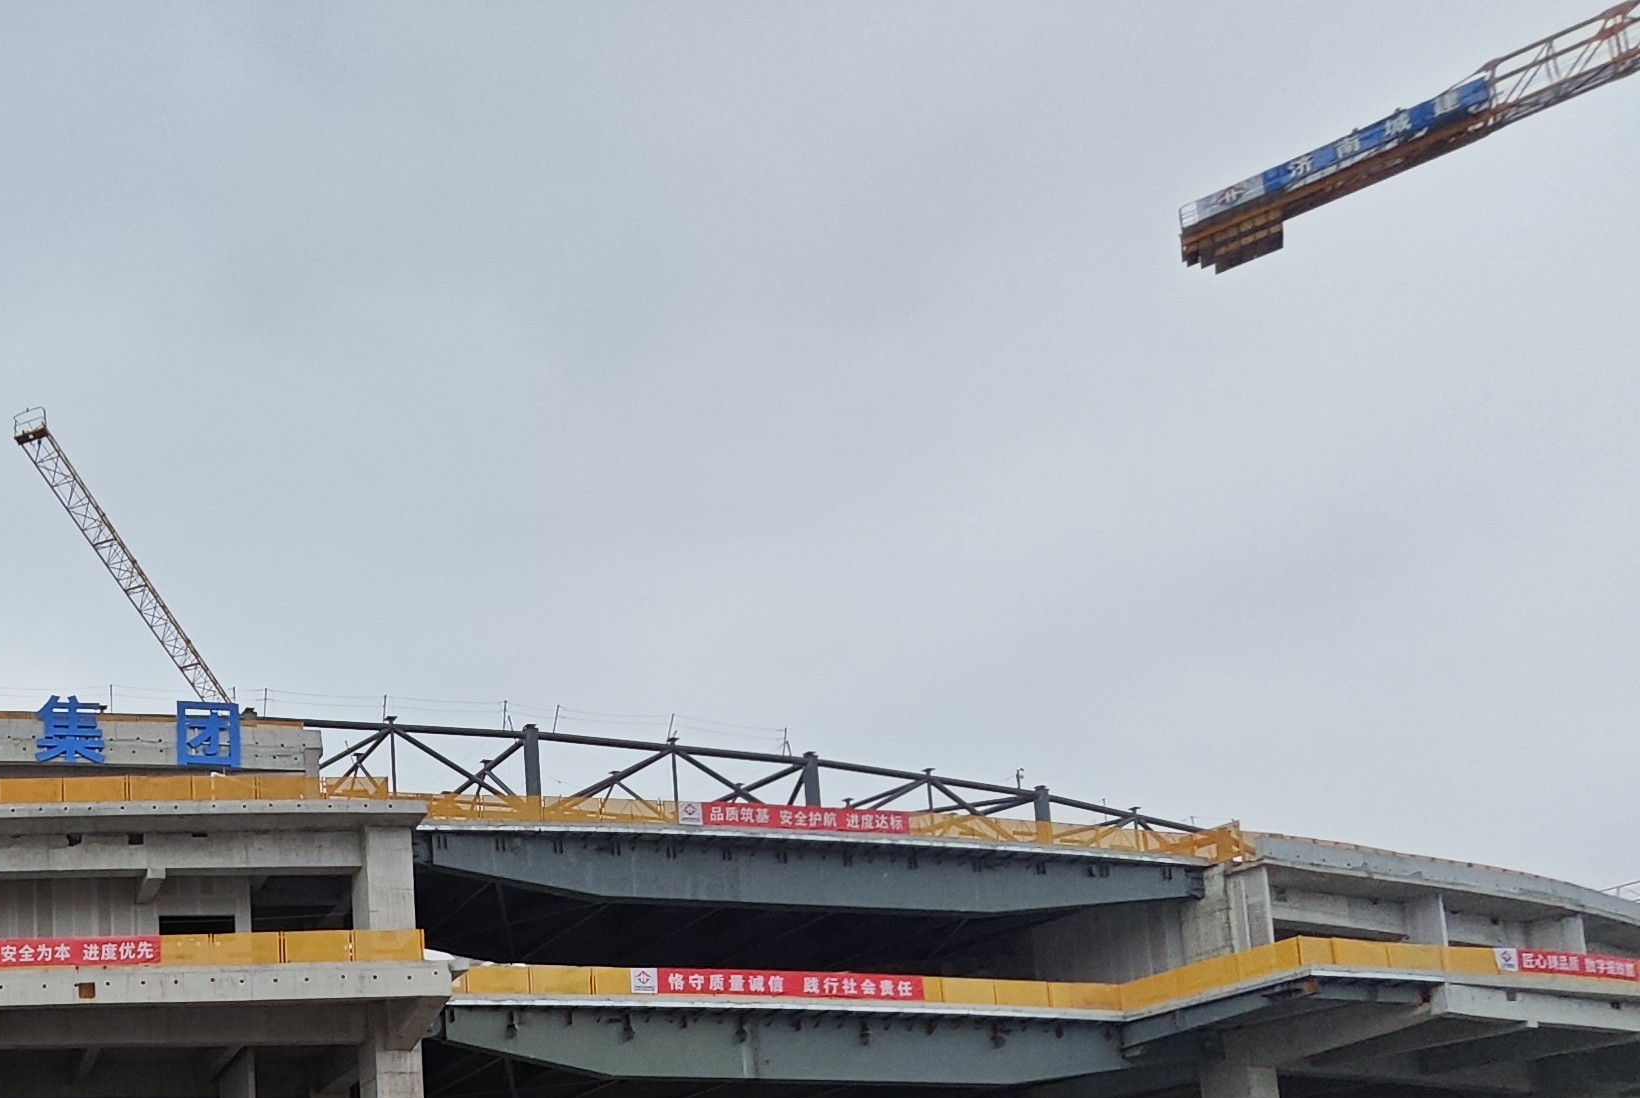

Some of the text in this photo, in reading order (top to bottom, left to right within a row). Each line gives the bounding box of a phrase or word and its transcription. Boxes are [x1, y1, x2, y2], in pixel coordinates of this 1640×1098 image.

[710, 806, 903, 829] 品质筑基 安全护航 进度达标
[0, 944, 72, 962] 安全为本
[82, 942, 154, 961] 进度优先
[668, 972, 912, 996] 恪守质量诚信 践行社会责任
